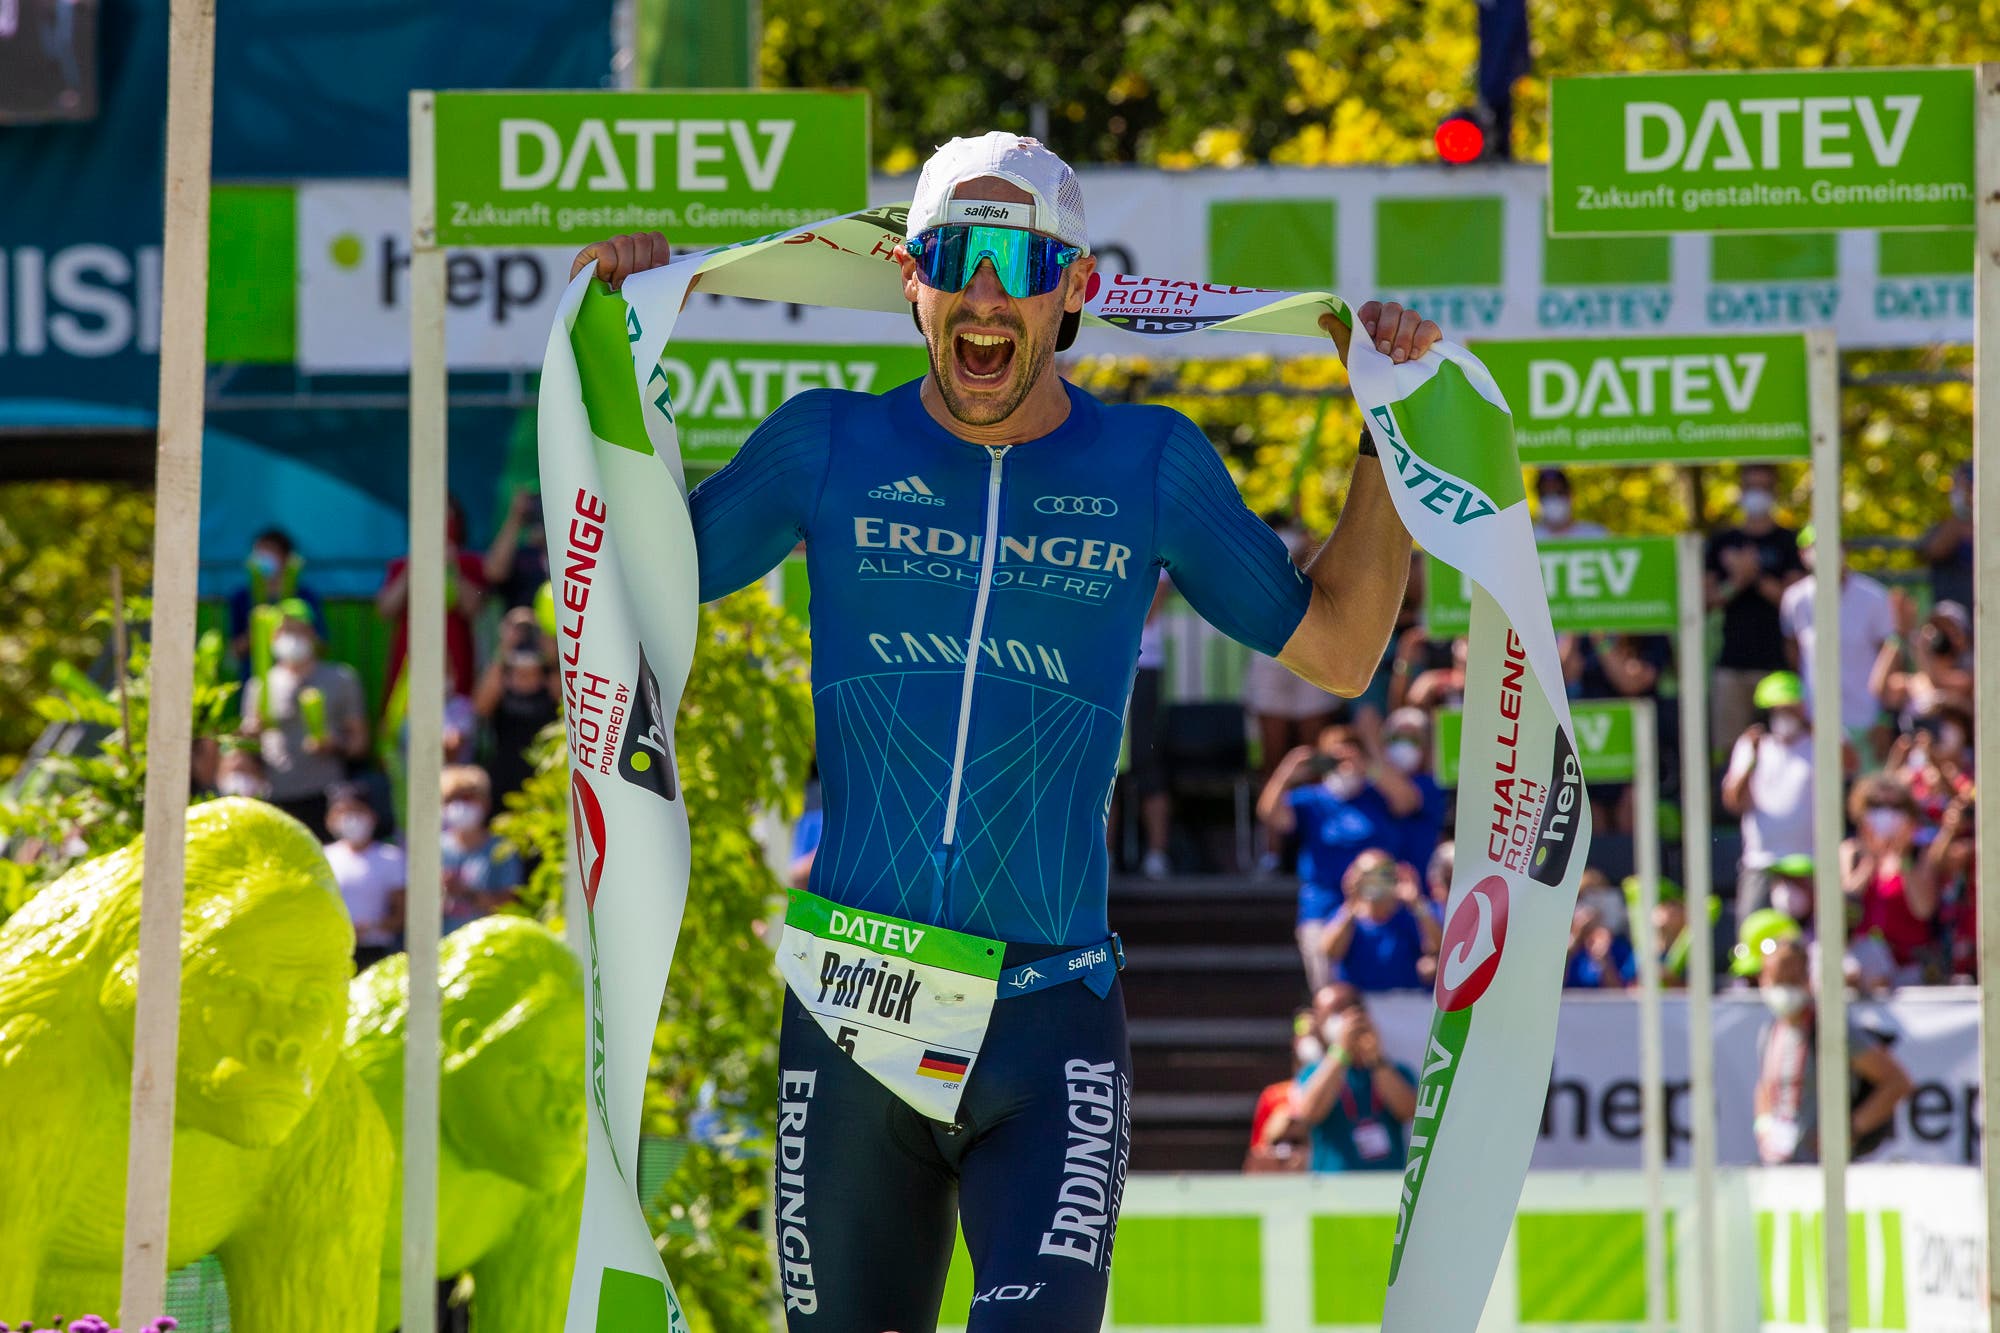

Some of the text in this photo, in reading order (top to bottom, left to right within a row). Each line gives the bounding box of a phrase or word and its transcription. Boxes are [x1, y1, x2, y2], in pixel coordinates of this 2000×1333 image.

[499, 119, 796, 193] DATEV
[1624, 95, 1923, 174] DATEV
[450, 202, 551, 226] Zukunft
[556, 203, 684, 232] gestalten.
[963, 205, 1009, 220] sailfish
[1576, 179, 1974, 212] Zukunft gestalten. Gemeinsam.
[0, 243, 163, 357] IS
[1100, 307, 1194, 316] POWERED BY
[1103, 289, 1199, 307] ROTH
[1874, 280, 1974, 320] DATE
[1527, 353, 1767, 420] DATEV
[1369, 404, 1496, 526] DATEV
[1515, 425, 1572, 447] kunft
[868, 488, 946, 507] adidas
[853, 516, 1132, 580] ERDINGER
[857, 557, 1113, 600] ALKOHOLFREI
[868, 631, 1070, 685] CANYON
[578, 671, 610, 770] ROTH
[599, 683, 630, 776] POWERED BY
[1488, 628, 1529, 864] CHALLENG
[1504, 778, 1538, 871] ROTH
[1518, 785, 1548, 874] POWERED BY
[1542, 753, 1580, 842] hep
[829, 909, 925, 954] DATEV
[1067, 948, 1108, 972] sailfish
[816, 950, 922, 1025] Patrick
[836, 1025, 859, 1054] 5
[942, 1082, 959, 1091] GER
[779, 1068, 818, 1316] ERDINGER
[1037, 1058, 1116, 1268] ERDINGER
